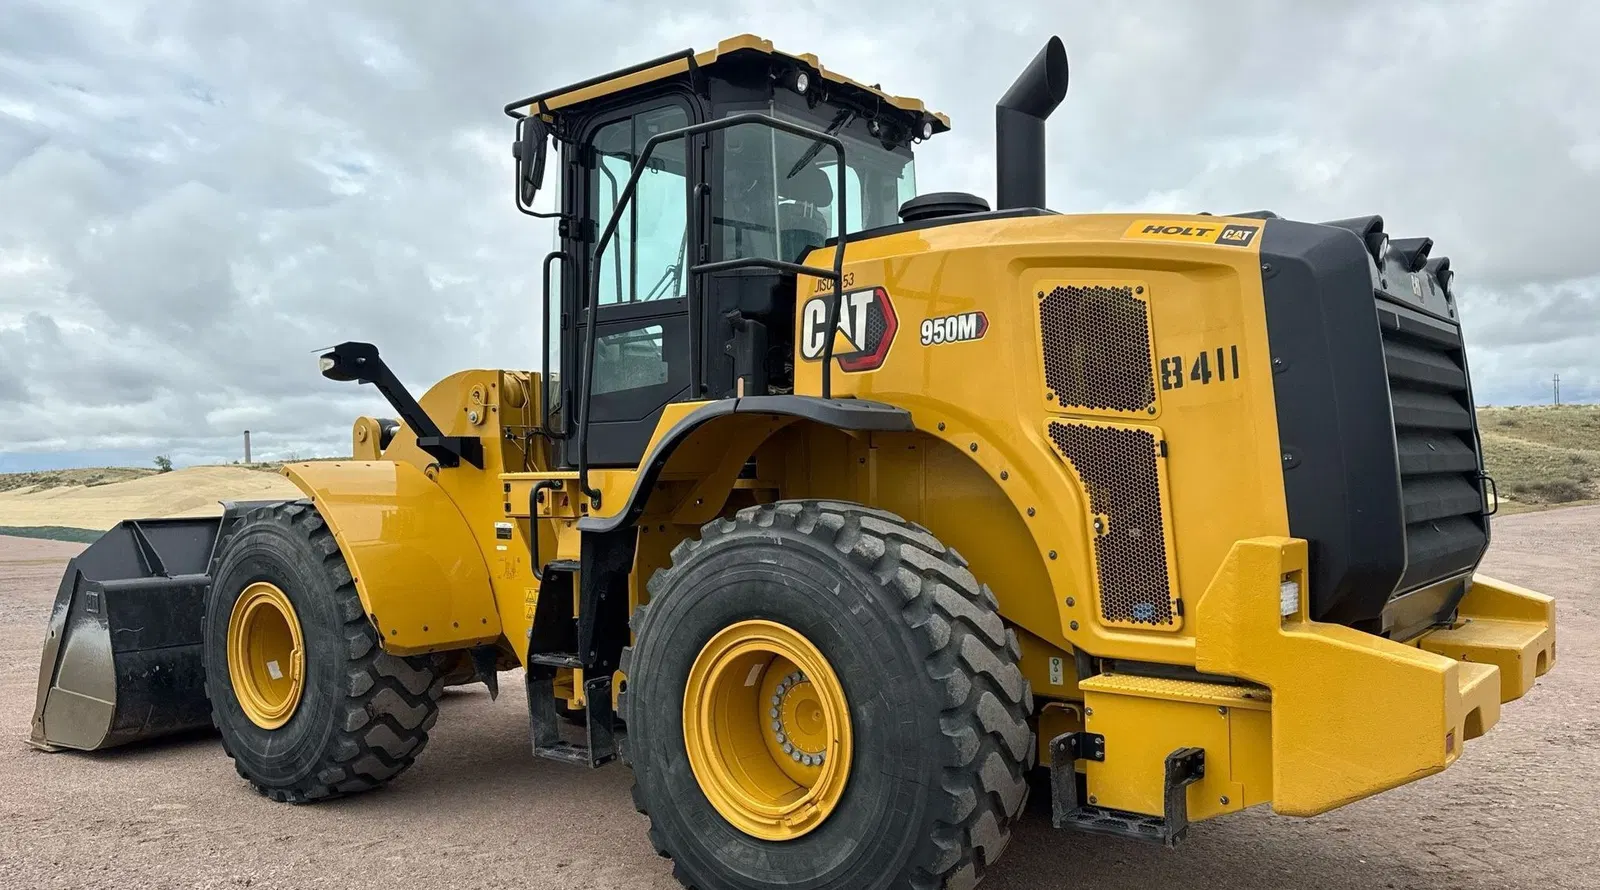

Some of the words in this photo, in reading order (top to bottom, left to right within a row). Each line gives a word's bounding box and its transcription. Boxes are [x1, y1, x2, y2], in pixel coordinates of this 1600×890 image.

[1142, 225, 1215, 236] HOLT
[1222, 229, 1253, 241] CAT
[921, 313, 977, 345] 950M
[1161, 345, 1239, 390] 8411
